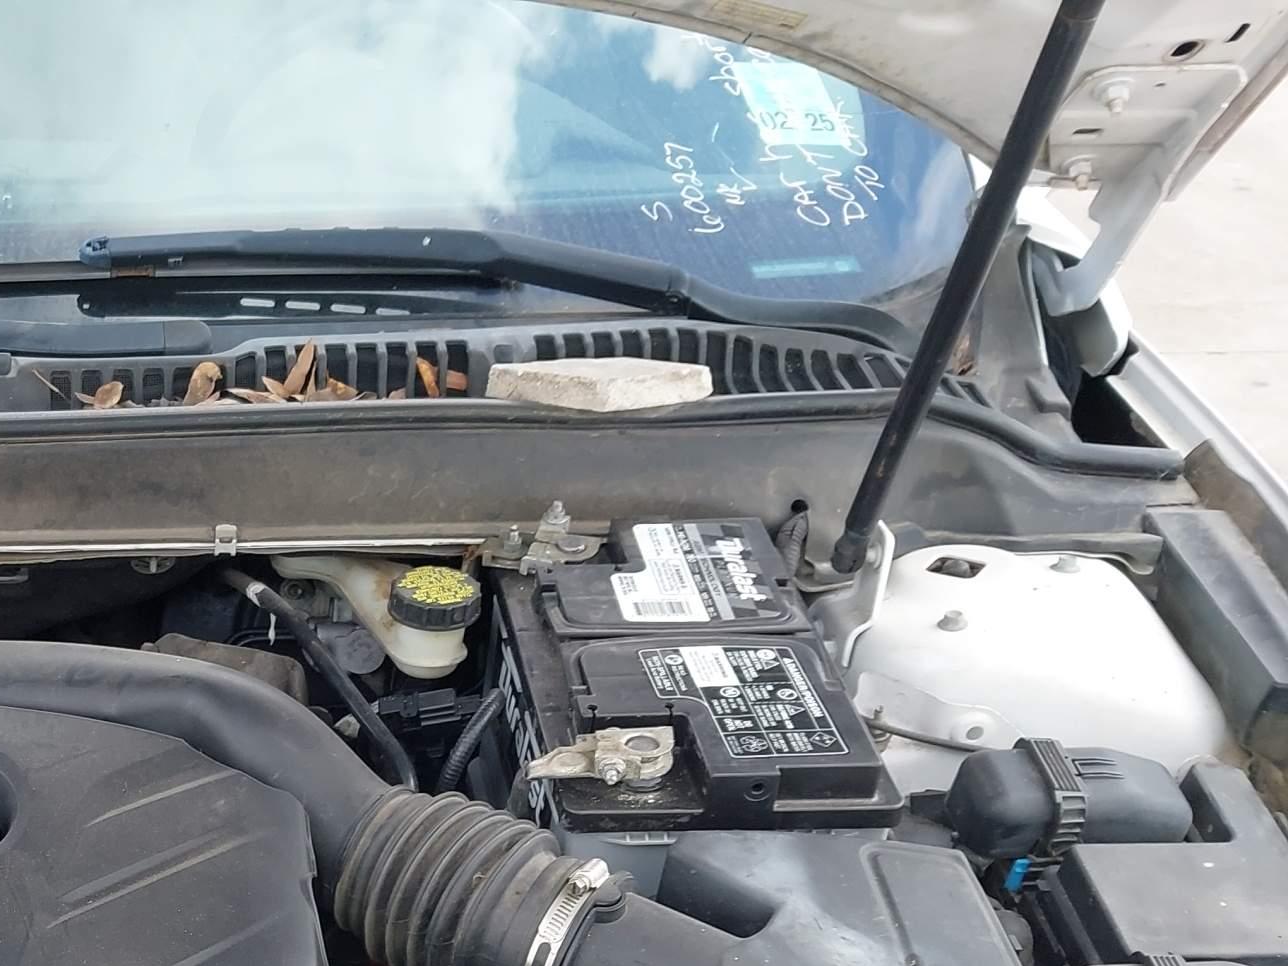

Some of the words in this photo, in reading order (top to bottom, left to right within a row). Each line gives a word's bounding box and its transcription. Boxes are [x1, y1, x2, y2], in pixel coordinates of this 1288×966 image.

[804, 112, 835, 131] 25
[713, 537, 767, 601] Duralast
[498, 641, 545, 829] Duralst
